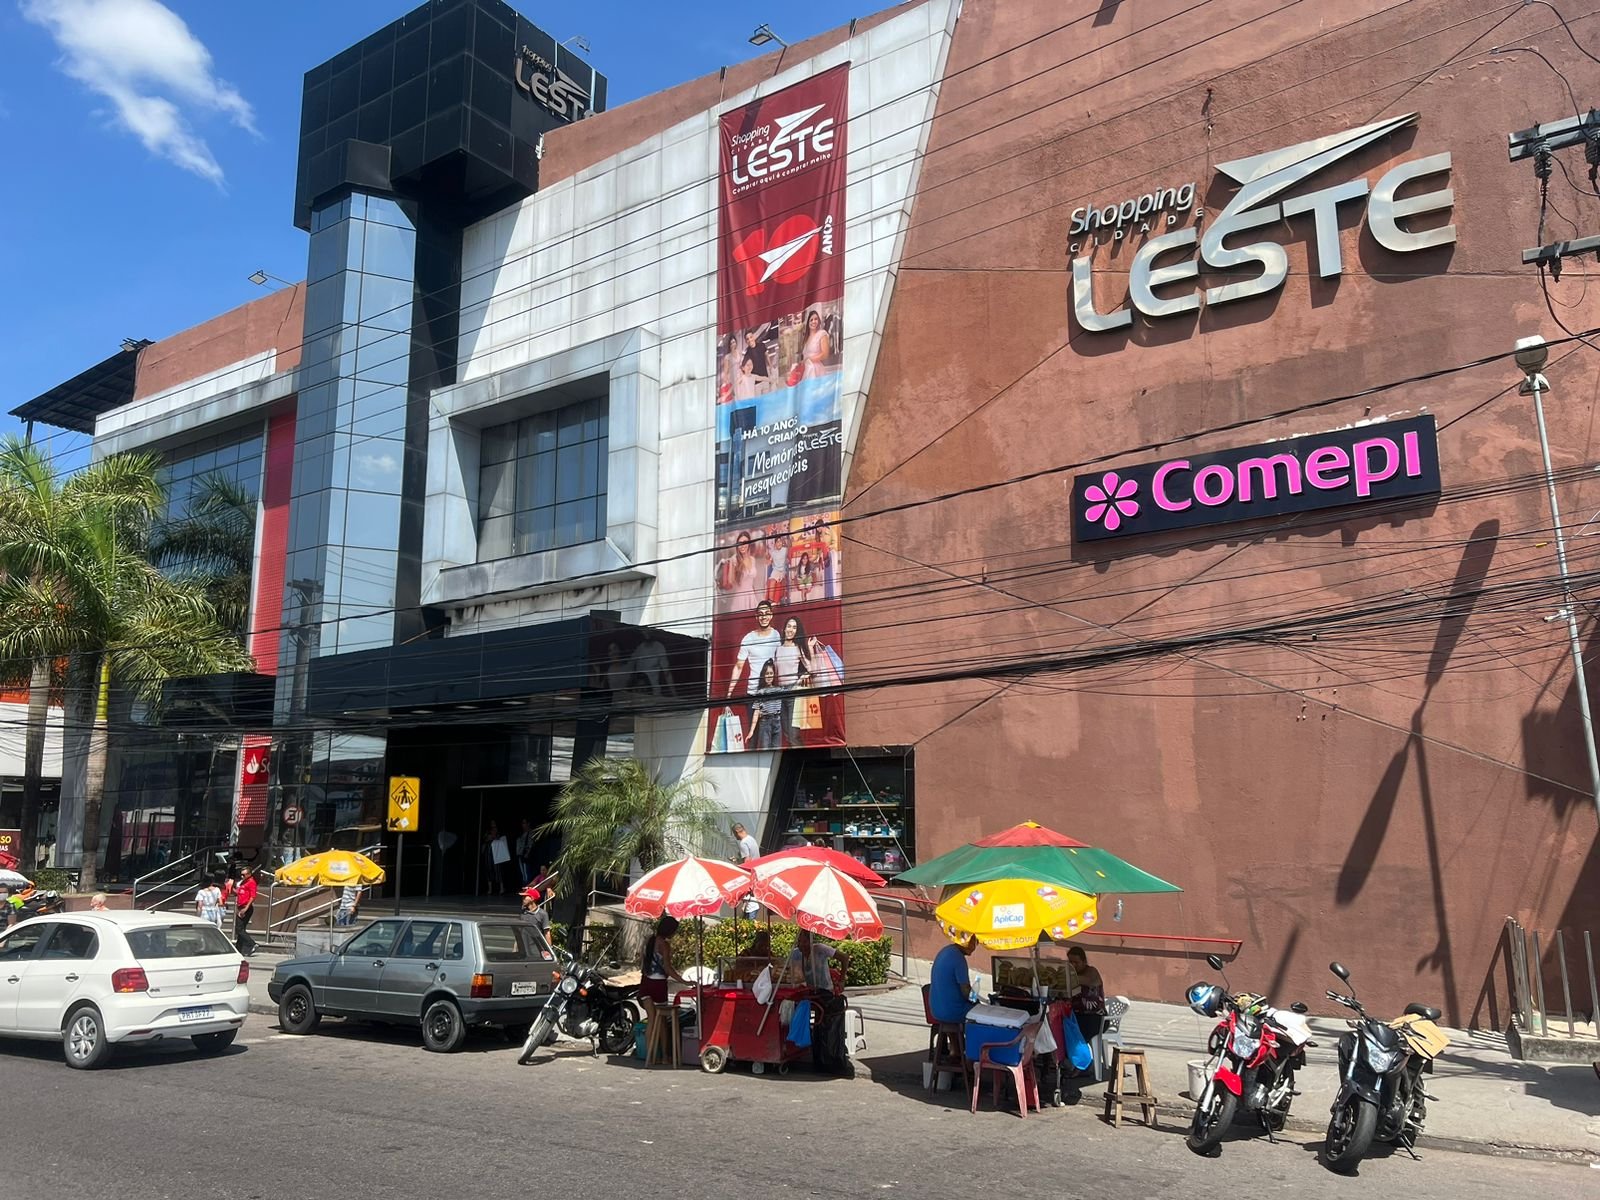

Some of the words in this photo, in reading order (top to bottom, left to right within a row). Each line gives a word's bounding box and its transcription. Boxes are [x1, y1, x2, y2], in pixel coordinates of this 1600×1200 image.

[731, 124, 770, 147] Shopping
[731, 136, 770, 155] CIDADE
[732, 117, 834, 185] LESTE
[1070, 182, 1196, 236] Shopping
[822, 215, 833, 255] ANOS
[1070, 208, 1205, 253] CIDADE
[1073, 150, 1457, 332] LESTE
[743, 426, 758, 440] HÁ
[760, 426, 770, 436] 10
[772, 416, 798, 433] ANOS
[803, 431, 843, 451] LESTE
